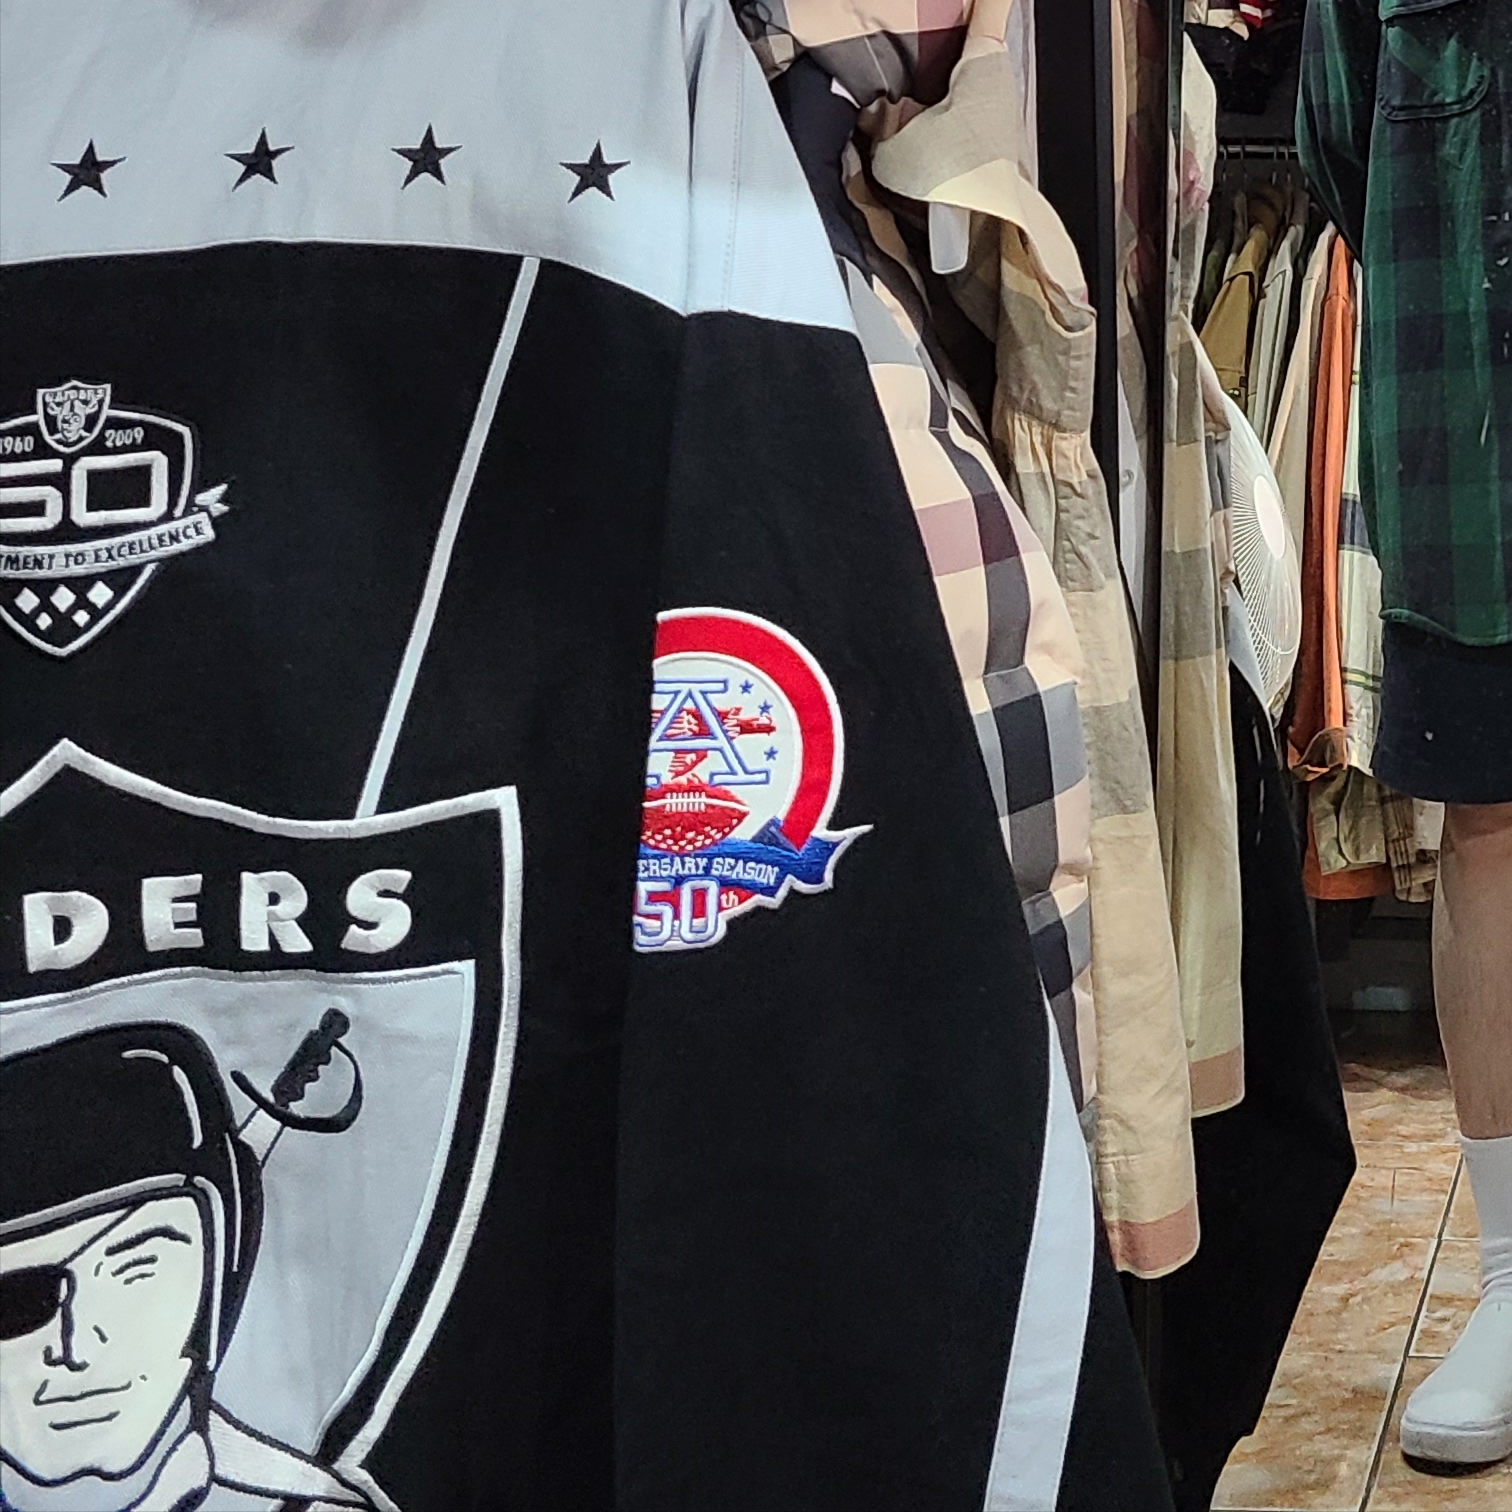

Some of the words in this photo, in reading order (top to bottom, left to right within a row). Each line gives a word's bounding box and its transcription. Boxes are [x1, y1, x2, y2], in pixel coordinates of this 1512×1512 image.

[104, 426, 145, 448] 2009
[64, 552, 87, 568] TO
[94, 520, 206, 563] EXCELLENCE
[711, 857, 779, 886] SEASON
[22, 868, 413, 974] DERS
